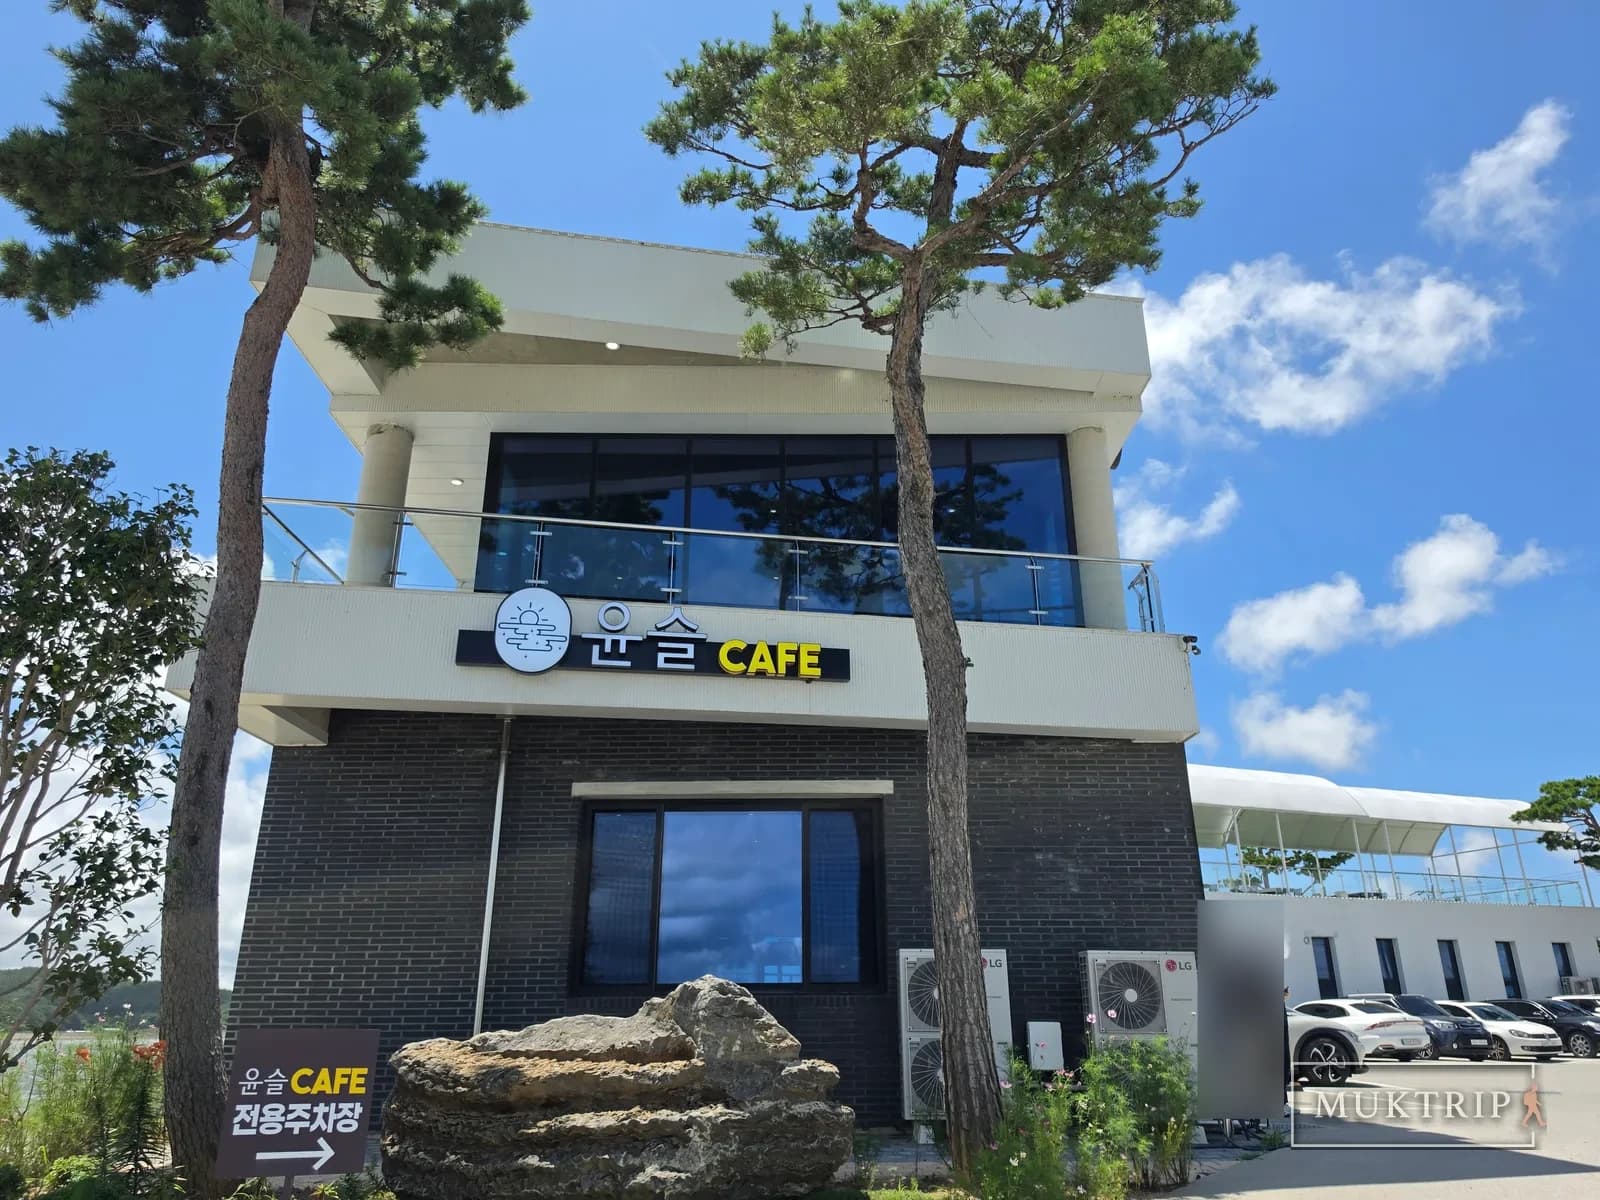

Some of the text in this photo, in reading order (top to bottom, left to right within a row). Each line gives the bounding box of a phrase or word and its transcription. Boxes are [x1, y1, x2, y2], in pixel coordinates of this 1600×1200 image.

[581, 601, 822, 679] 윤슬 CAFE
[989, 959, 1003, 968] LG
[1178, 961, 1193, 971] LG
[238, 1067, 369, 1096] 윤슬 CAFE
[232, 1102, 363, 1136] 전용주차장
